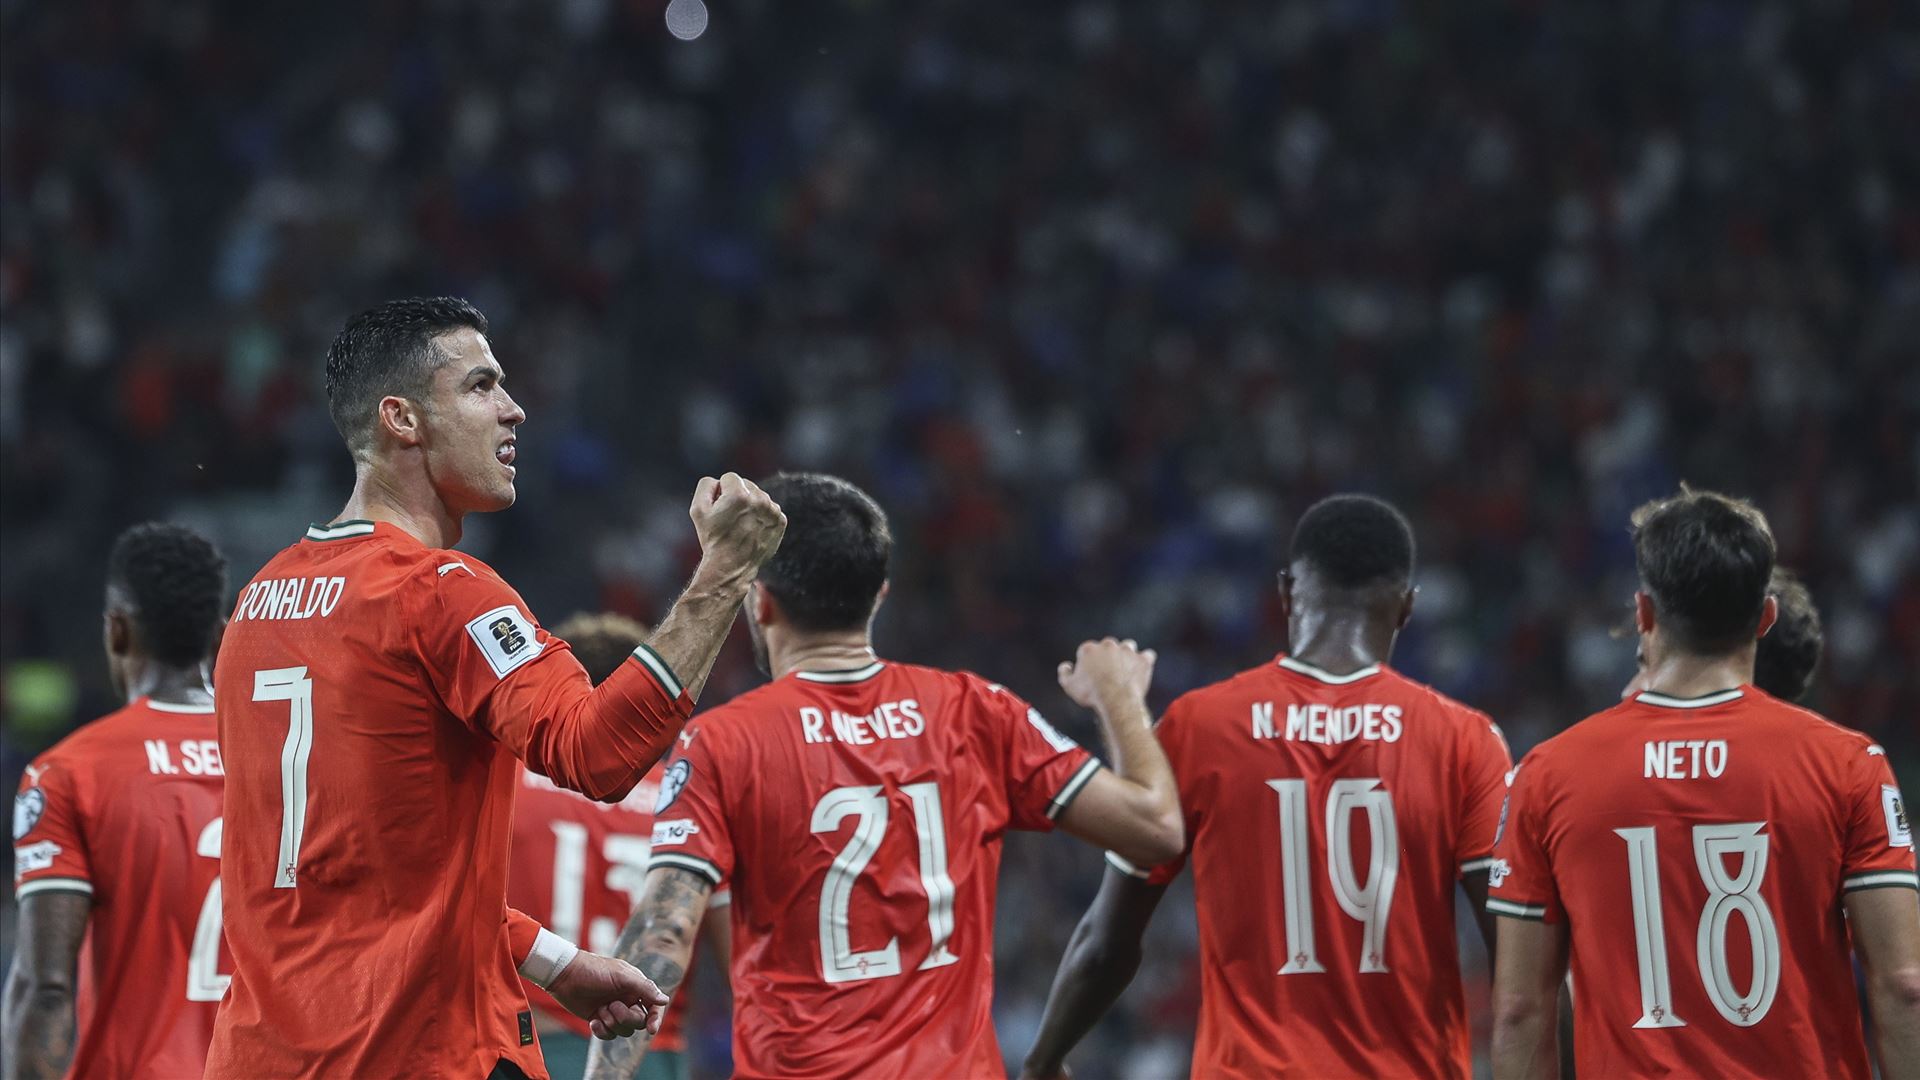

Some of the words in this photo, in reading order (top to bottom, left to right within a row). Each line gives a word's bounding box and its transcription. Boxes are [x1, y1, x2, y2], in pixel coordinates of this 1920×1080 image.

[235, 577, 345, 623] RONALDO
[180, 739, 225, 776] SE
[252, 666, 312, 888] 7
[1285, 704, 1403, 745] MENDES
[1644, 740, 1728, 779] NETO
[810, 782, 960, 983] 21
[1264, 778, 1399, 975] 19
[1612, 821, 1781, 1027] 18
